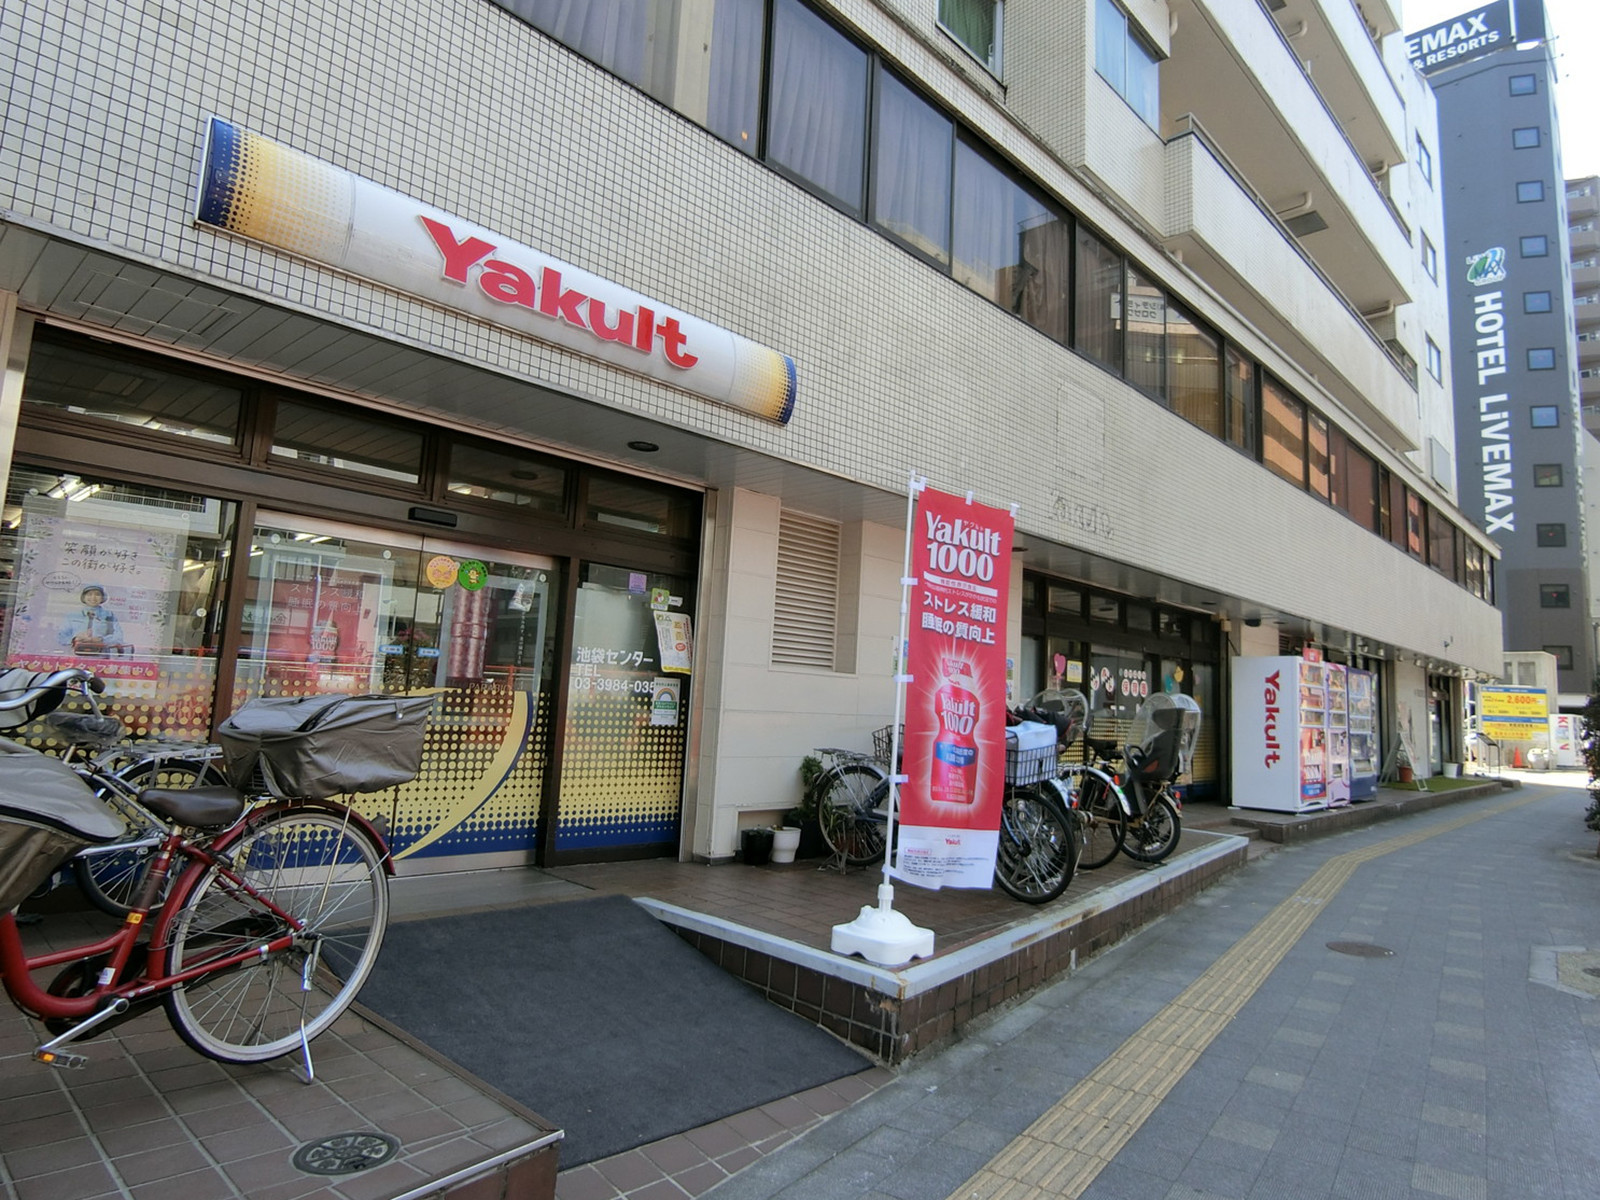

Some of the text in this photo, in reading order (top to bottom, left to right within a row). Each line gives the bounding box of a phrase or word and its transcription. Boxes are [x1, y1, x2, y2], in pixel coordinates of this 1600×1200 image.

[1426, 31, 1500, 66] RESORTS
[420, 215, 699, 370] Yakult
[1474, 291, 1507, 385] HOTEL
[925, 510, 1002, 557] Yakult
[62, 558, 142, 575] この街が好き。
[64, 541, 139, 561] 笑顔が好き
[926, 541, 994, 582] 1000
[923, 591, 996, 623] ストレス緩和
[921, 612, 996, 645] 睡眠の質向上
[575, 662, 601, 677] TEL
[576, 646, 654, 667] 池袋センター
[1264, 669, 1281, 769] Yakult
